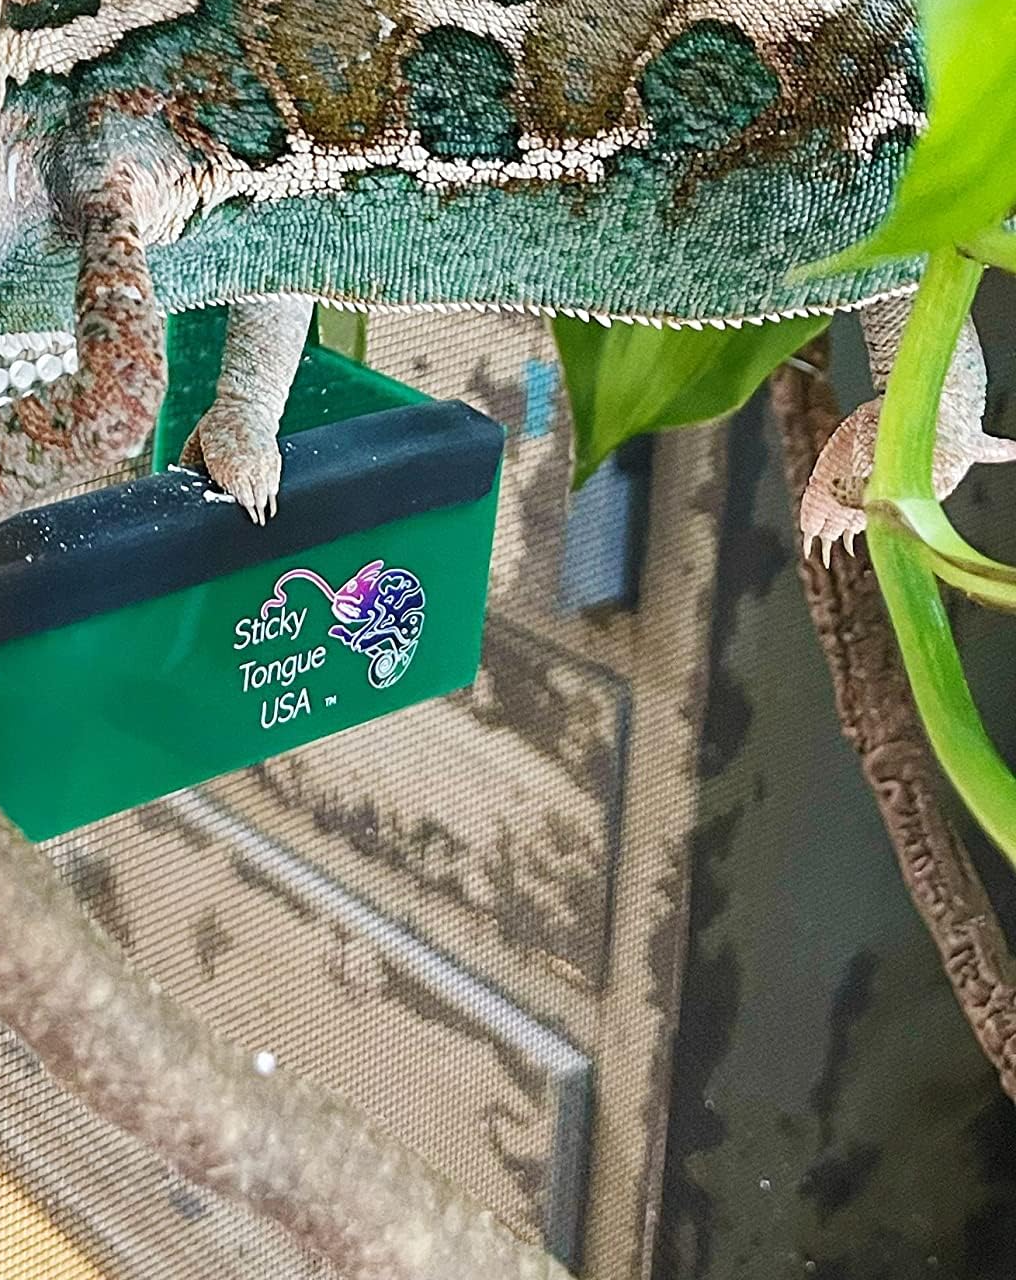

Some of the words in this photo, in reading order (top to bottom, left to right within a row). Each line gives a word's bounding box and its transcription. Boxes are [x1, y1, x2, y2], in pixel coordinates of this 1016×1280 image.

[234, 607, 308, 650] Sticky
[239, 646, 327, 693] Tongue
[260, 688, 311, 729] USA
